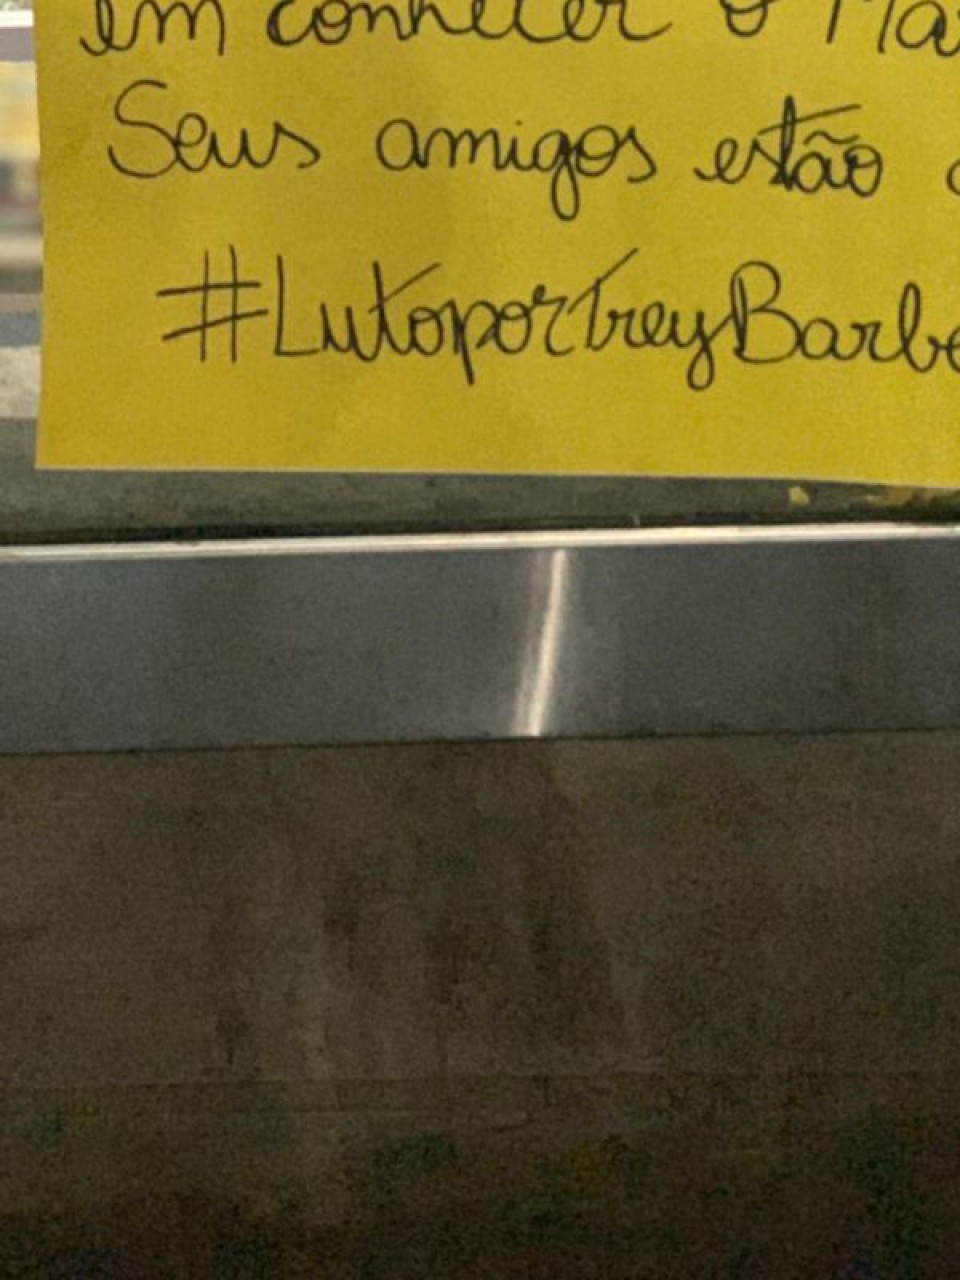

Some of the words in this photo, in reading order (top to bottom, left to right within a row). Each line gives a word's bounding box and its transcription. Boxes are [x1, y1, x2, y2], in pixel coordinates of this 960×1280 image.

[107, 79, 322, 179] Seus
[375, 117, 658, 222] amigos
[693, 94, 884, 199] estão
